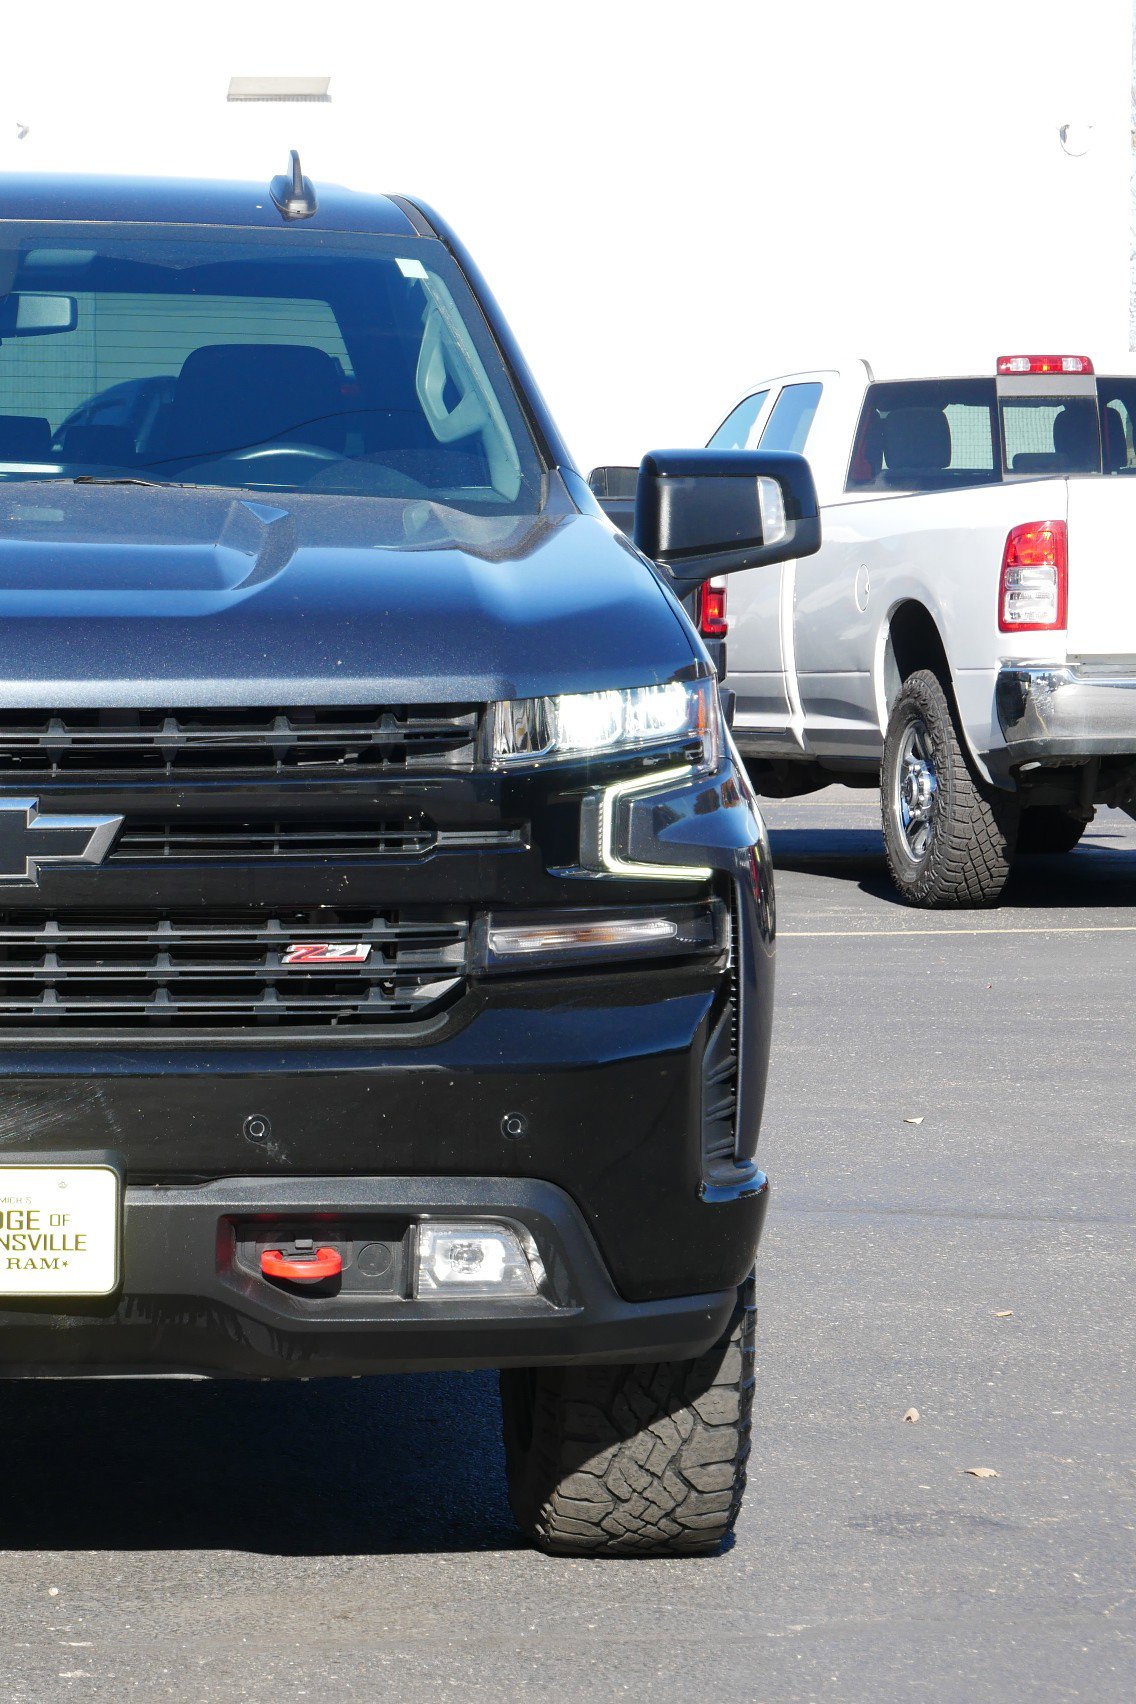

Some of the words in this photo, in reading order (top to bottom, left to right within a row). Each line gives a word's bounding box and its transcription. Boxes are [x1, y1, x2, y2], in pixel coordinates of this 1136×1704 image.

[281, 943, 372, 963] Z71
[49, 1213, 71, 1227] OF
[6, 1257, 60, 1270] RAM
